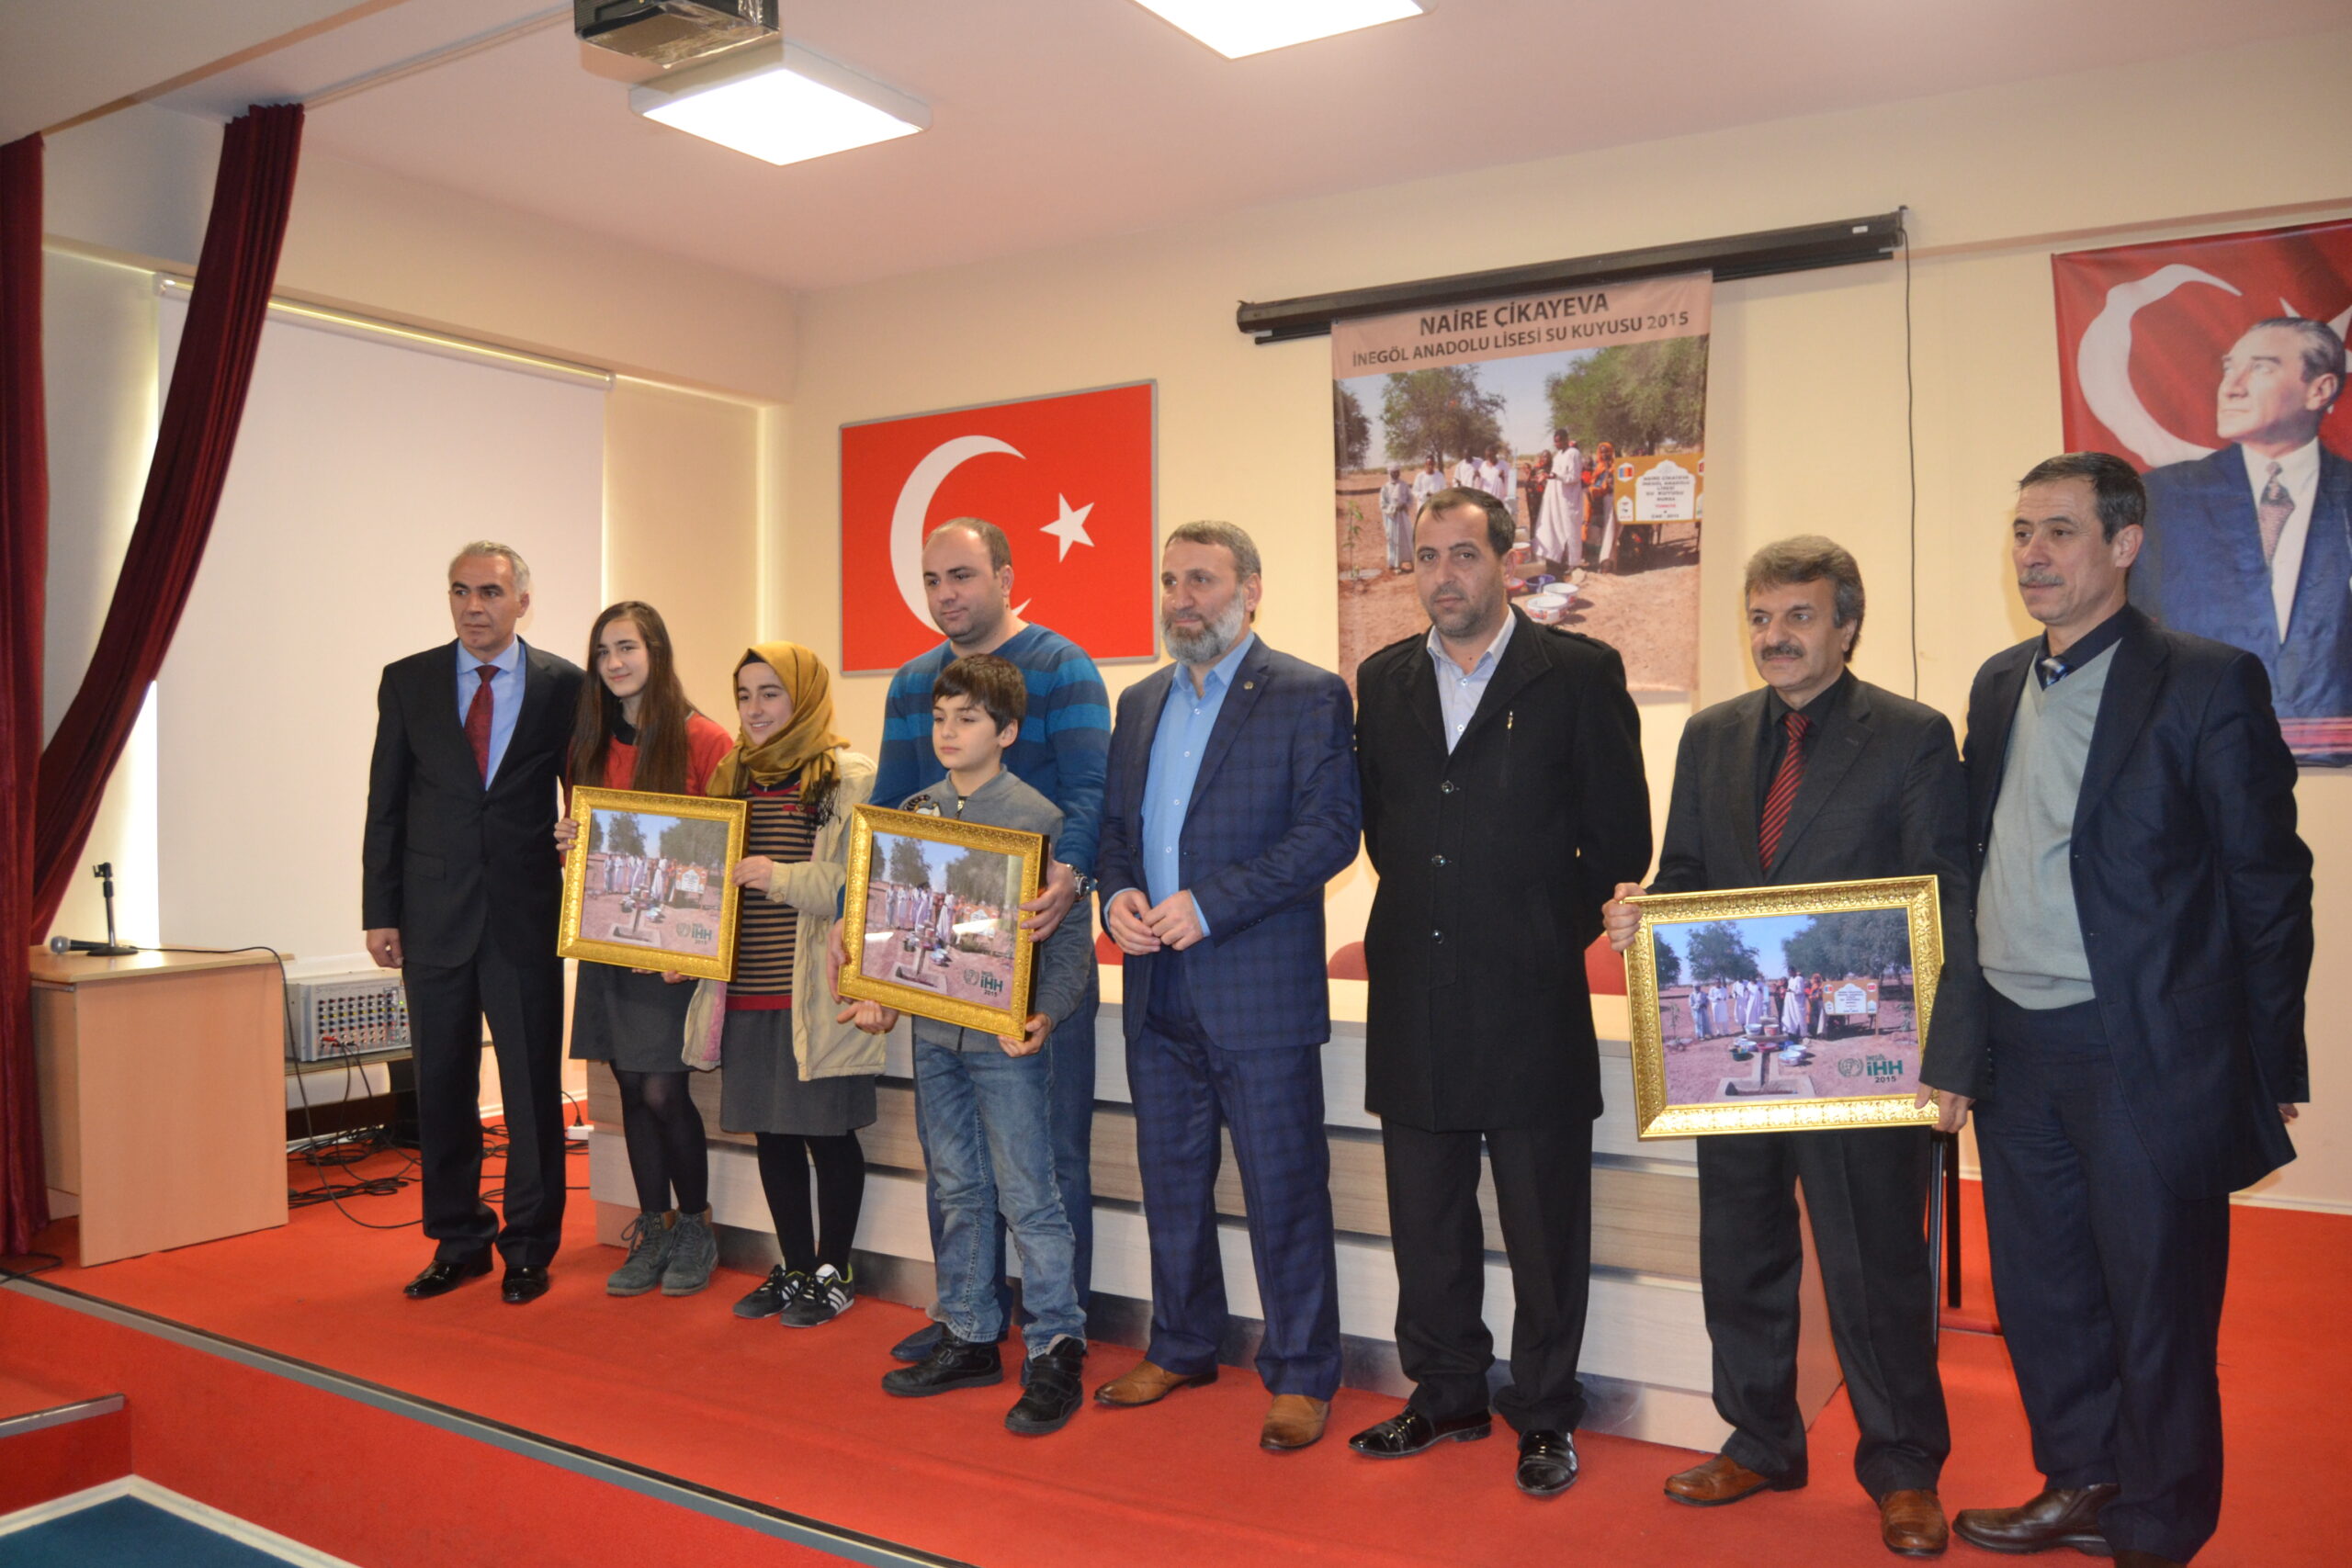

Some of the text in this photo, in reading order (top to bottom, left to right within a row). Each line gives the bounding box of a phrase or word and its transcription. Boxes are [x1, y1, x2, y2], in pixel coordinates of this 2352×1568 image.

[1352, 311, 1690, 367] İNEGÖL ANADOLU LİSESİ SU KUYUSU 2015
[1419, 293, 1610, 336] NAİRE ÇİKAYEVA
